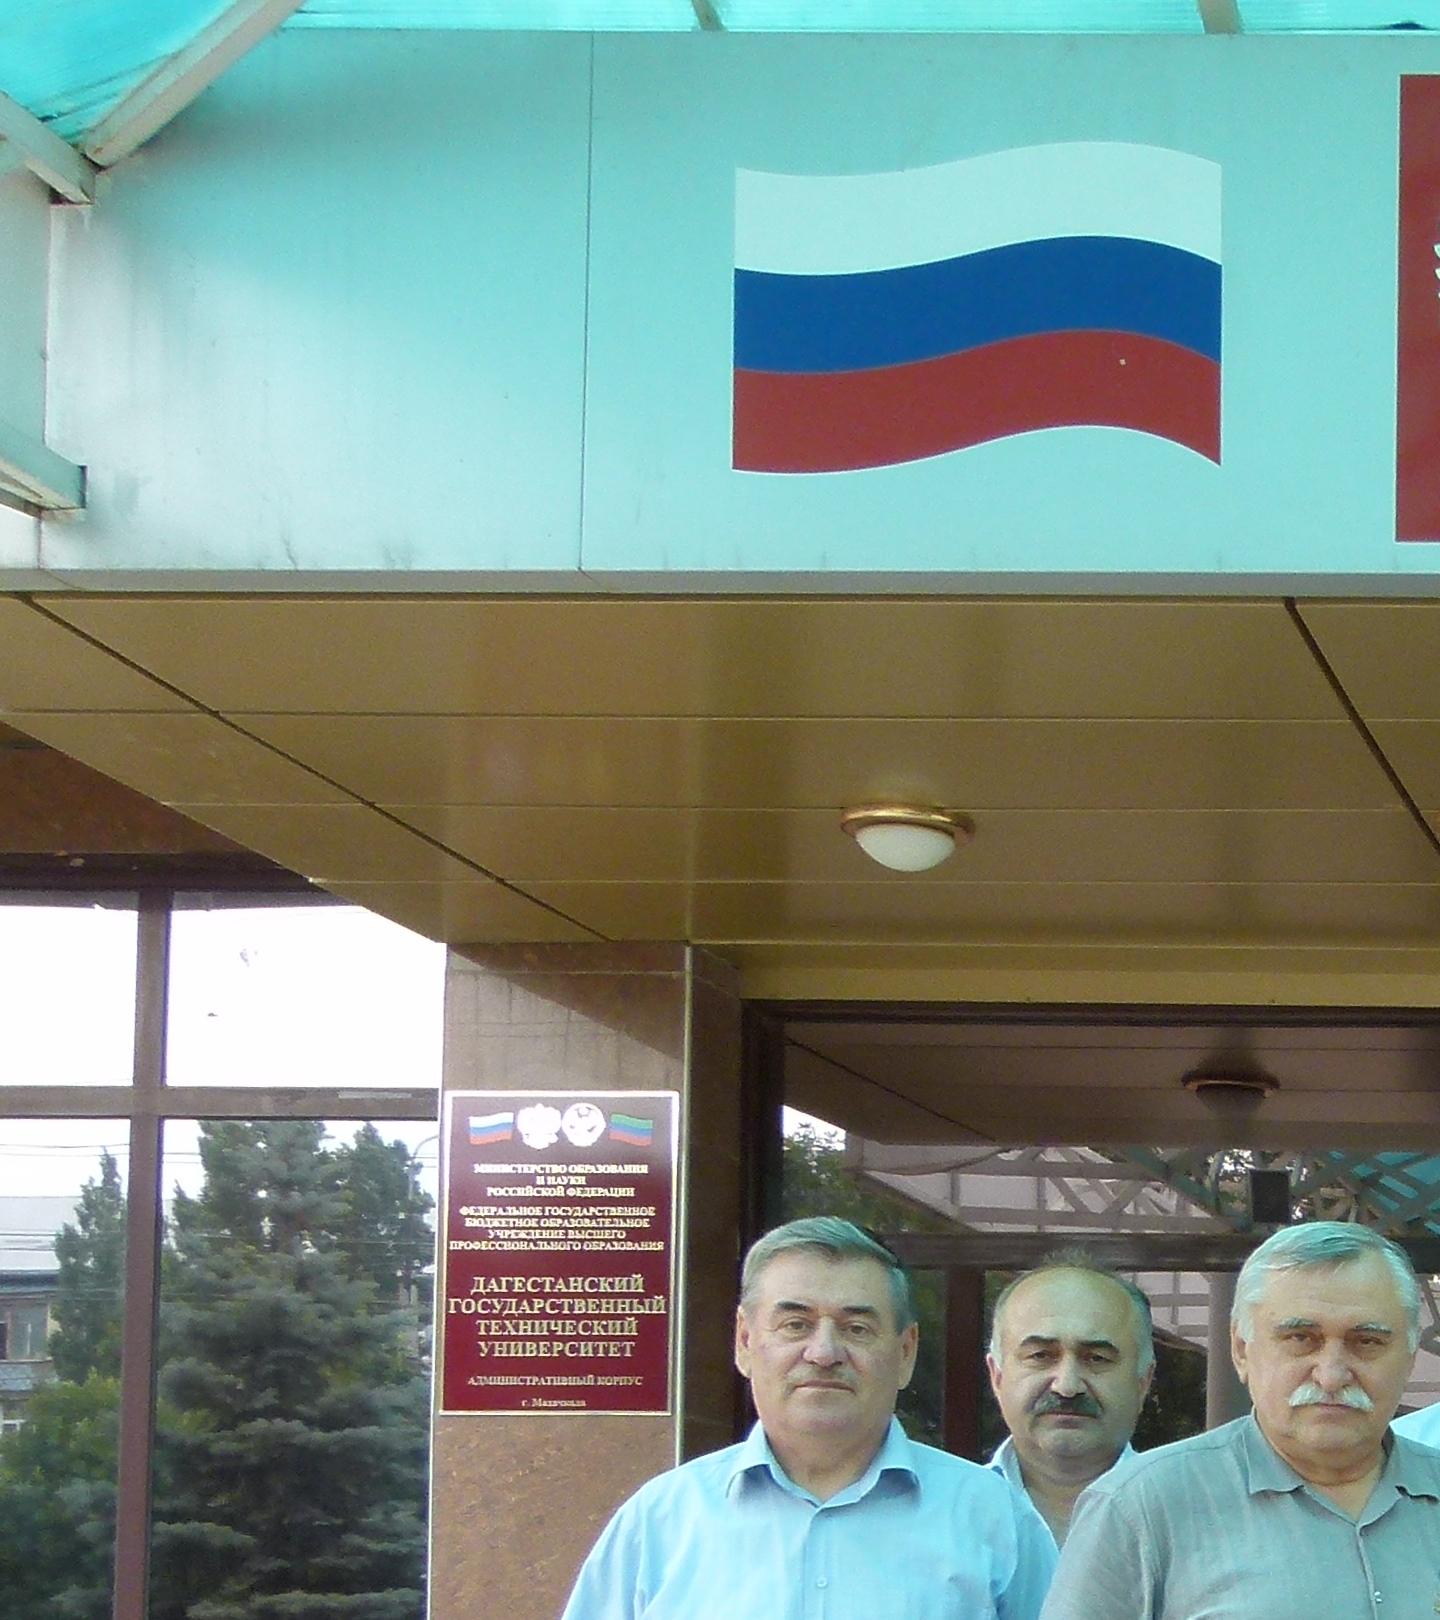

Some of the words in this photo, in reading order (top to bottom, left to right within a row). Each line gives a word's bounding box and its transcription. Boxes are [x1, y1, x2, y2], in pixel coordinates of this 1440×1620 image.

[474, 1164, 567, 1174] МИНИСТЕРСТВО
[568, 1164, 648, 1174] ОБРАЗОВАНИЯ
[547, 1176, 586, 1185] НАУКИ
[487, 1185, 565, 1197] РОССИЙСКОЙ
[566, 1187, 635, 1197] ФЕДЕРАЦИИ
[460, 1206, 542, 1217] ФЕДЕРАЛЬНОЕ
[544, 1206, 656, 1217] ГОСУДАРСТВЕННОЕ
[465, 1218, 539, 1228] БЮДЖЕТНОЕ
[540, 1218, 650, 1228] ОБРАЗОВАТЕЛЬНОЕ
[488, 1229, 566, 1239] УЧРЕЖДЕНИЕ
[568, 1229, 626, 1239] ВЫСШЕГО
[449, 1241, 581, 1251] ПРОФЕССИОНАЛЬНОГО
[583, 1240, 664, 1251] ОБРАЗОВАНИЯ
[470, 1273, 645, 1295] ДАГЕСТАНСКИЙ
[448, 1295, 667, 1316] ГОСУДАРСТВЕННЫЙ
[475, 1316, 639, 1336] ТЕХНИЧЕСКИЙ
[477, 1341, 636, 1357] УНИВЕРСИТЕТ
[467, 1374, 595, 1386] АДМИНИСТРАТИВНЫЙ
[597, 1376, 643, 1386] КОРПУС
